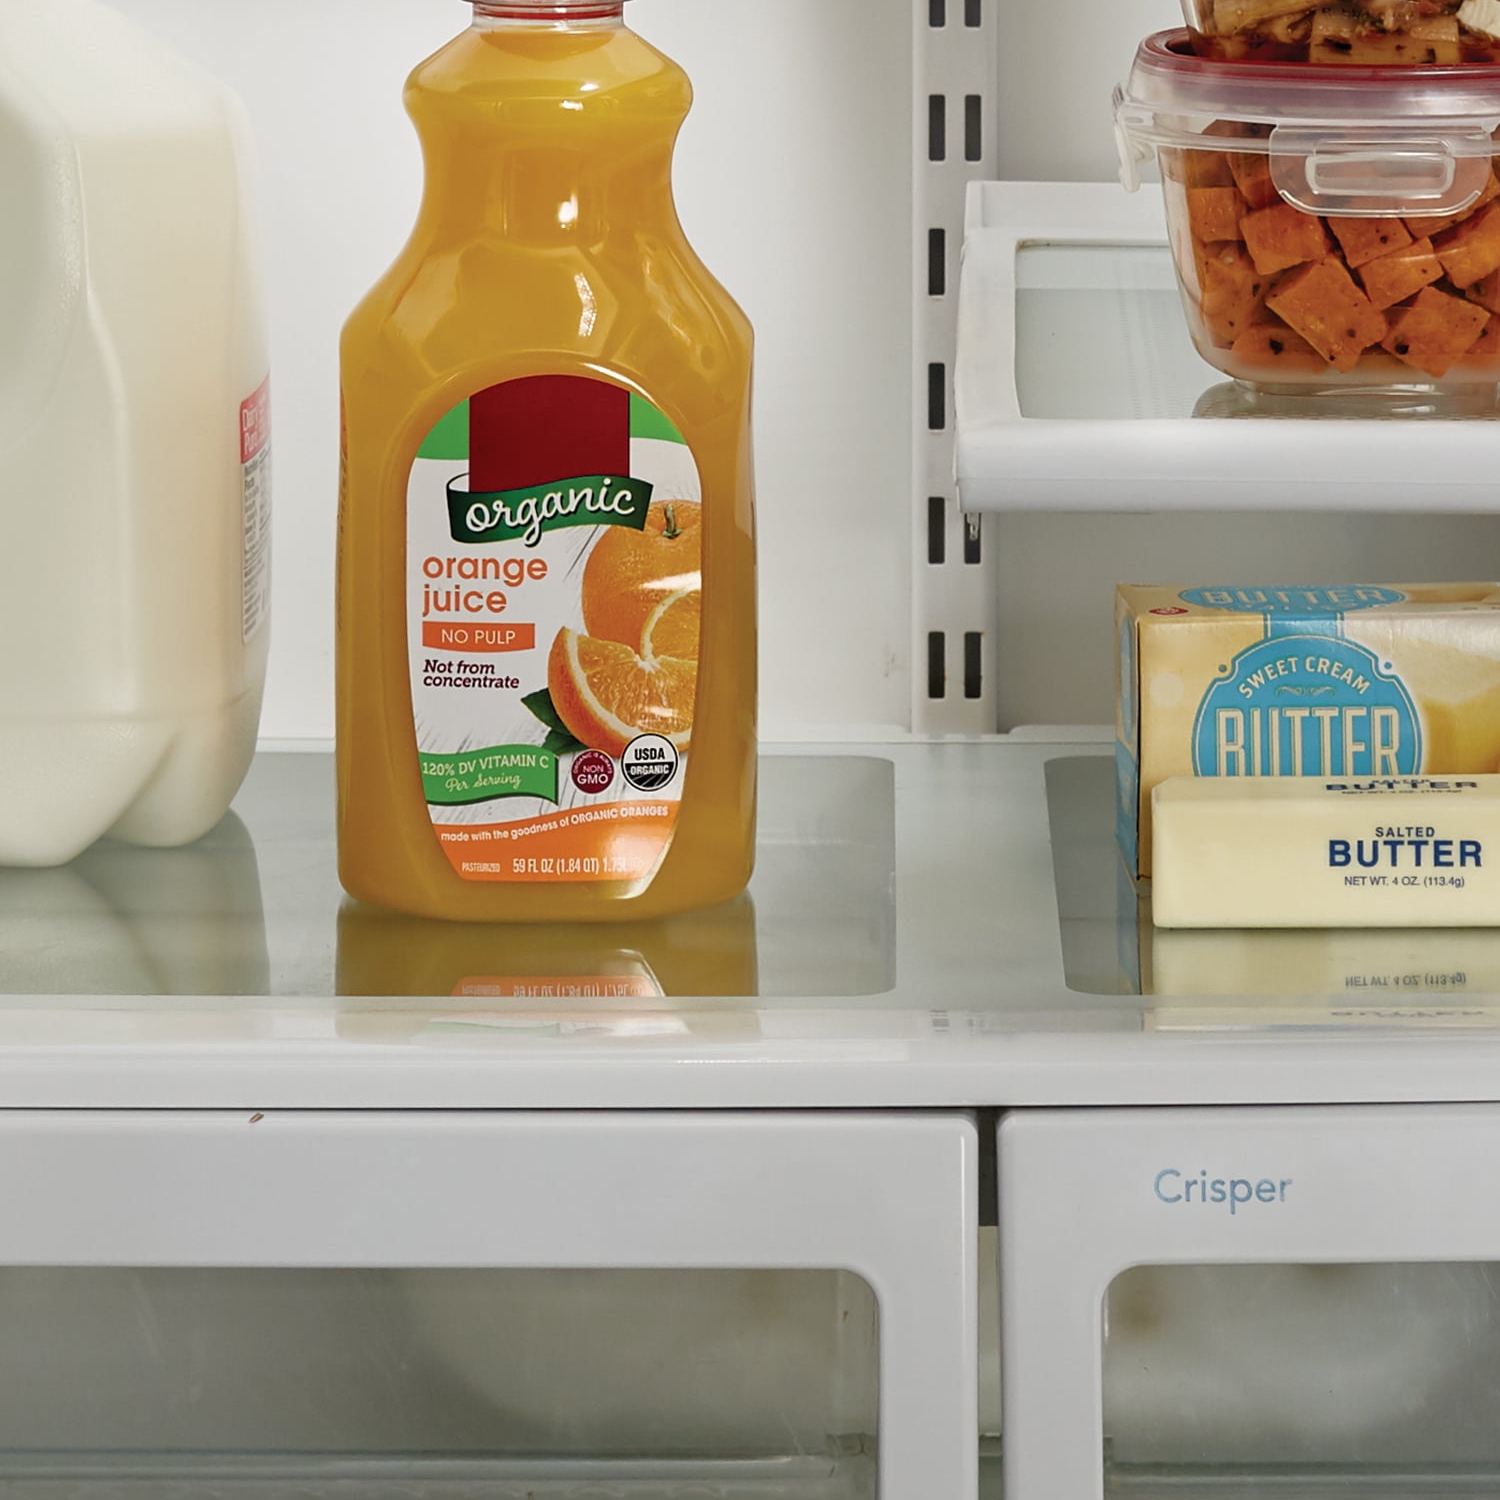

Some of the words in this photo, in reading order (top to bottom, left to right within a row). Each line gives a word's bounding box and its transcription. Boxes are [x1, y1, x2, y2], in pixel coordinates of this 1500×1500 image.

[466, 478, 635, 546] organic
[422, 556, 548, 587] orange
[422, 584, 507, 617] juice
[1201, 589, 1387, 604] BUTTER
[441, 629, 469, 644] NO
[474, 630, 516, 645] PULP
[423, 659, 453, 674] Not
[456, 660, 495, 675] from
[423, 675, 520, 689] concentrate
[1238, 657, 1299, 699] SWEET
[1305, 656, 1371, 695] CREAM
[1216, 706, 1401, 777] BUTTER
[634, 747, 666, 761] USDA
[422, 762, 456, 776] 120%
[458, 760, 477, 775] DV
[478, 755, 537, 769] VITAMIN
[539, 755, 549, 769] C
[583, 764, 604, 773] NON
[630, 764, 670, 776] ORGANIC
[445, 776, 469, 793] Per
[472, 773, 522, 790] Serving
[577, 773, 609, 785] GMO
[1326, 781, 1478, 791] BUTTER
[441, 831, 469, 842] made
[471, 829, 491, 841] with
[493, 829, 509, 840] the
[510, 821, 558, 840] goodness
[559, 817, 570, 828] of
[570, 807, 618, 825] ORGANIC
[619, 806, 669, 818] ORANGES
[1375, 826, 1435, 838] SALTED
[1329, 840, 1482, 868] BUTTER
[461, 862, 501, 873] PASTEURIZED
[513, 858, 526, 873] 59
[527, 858, 538, 873] FL
[541, 858, 554, 873] OZ
[556, 857, 581, 875] (1.84
[582, 857, 600, 875] QT)
[1344, 876, 1367, 886] NET
[1369, 876, 1389, 886] WT.
[1392, 876, 1399, 886] 4
[1401, 876, 1421, 886] OZ.
[1423, 876, 1465, 888] (113.4g)
[1153, 1168, 1293, 1215] Crisper
